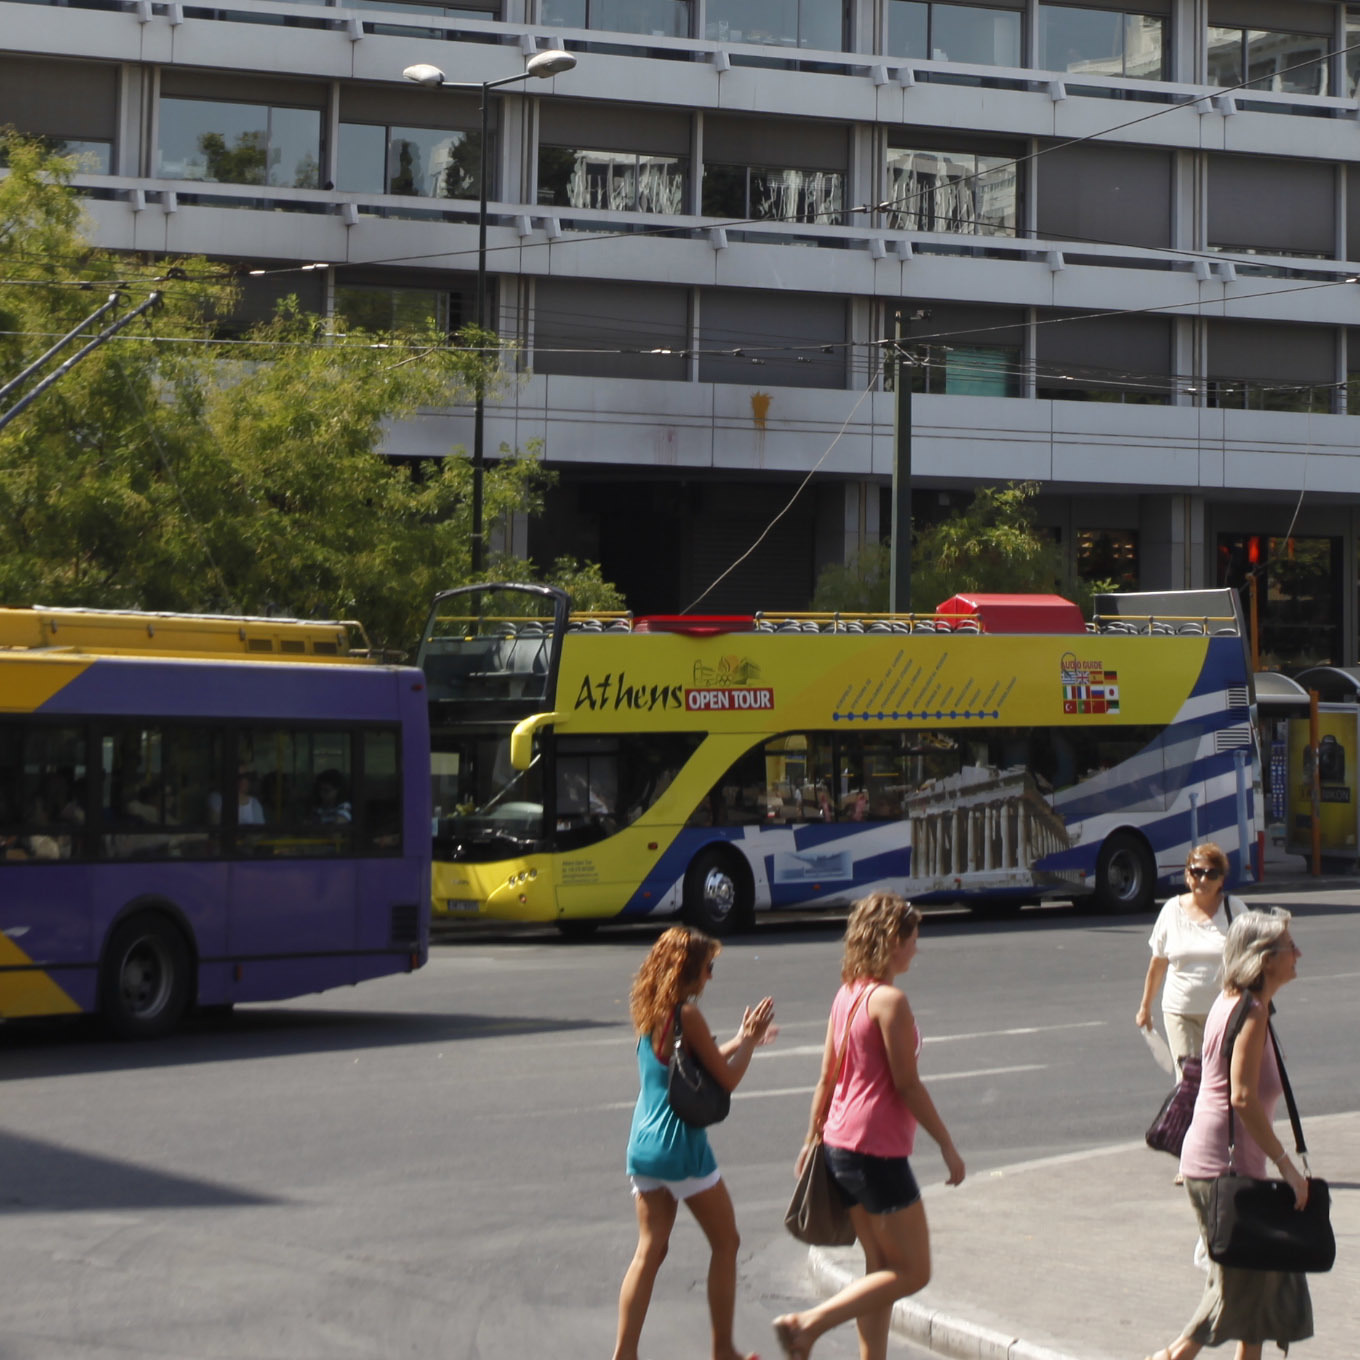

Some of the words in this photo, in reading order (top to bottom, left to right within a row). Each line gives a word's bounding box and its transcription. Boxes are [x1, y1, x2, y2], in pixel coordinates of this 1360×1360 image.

[574, 671, 683, 711] Athens
[688, 691, 729, 709] OPEN
[732, 690, 771, 709] TOUR
